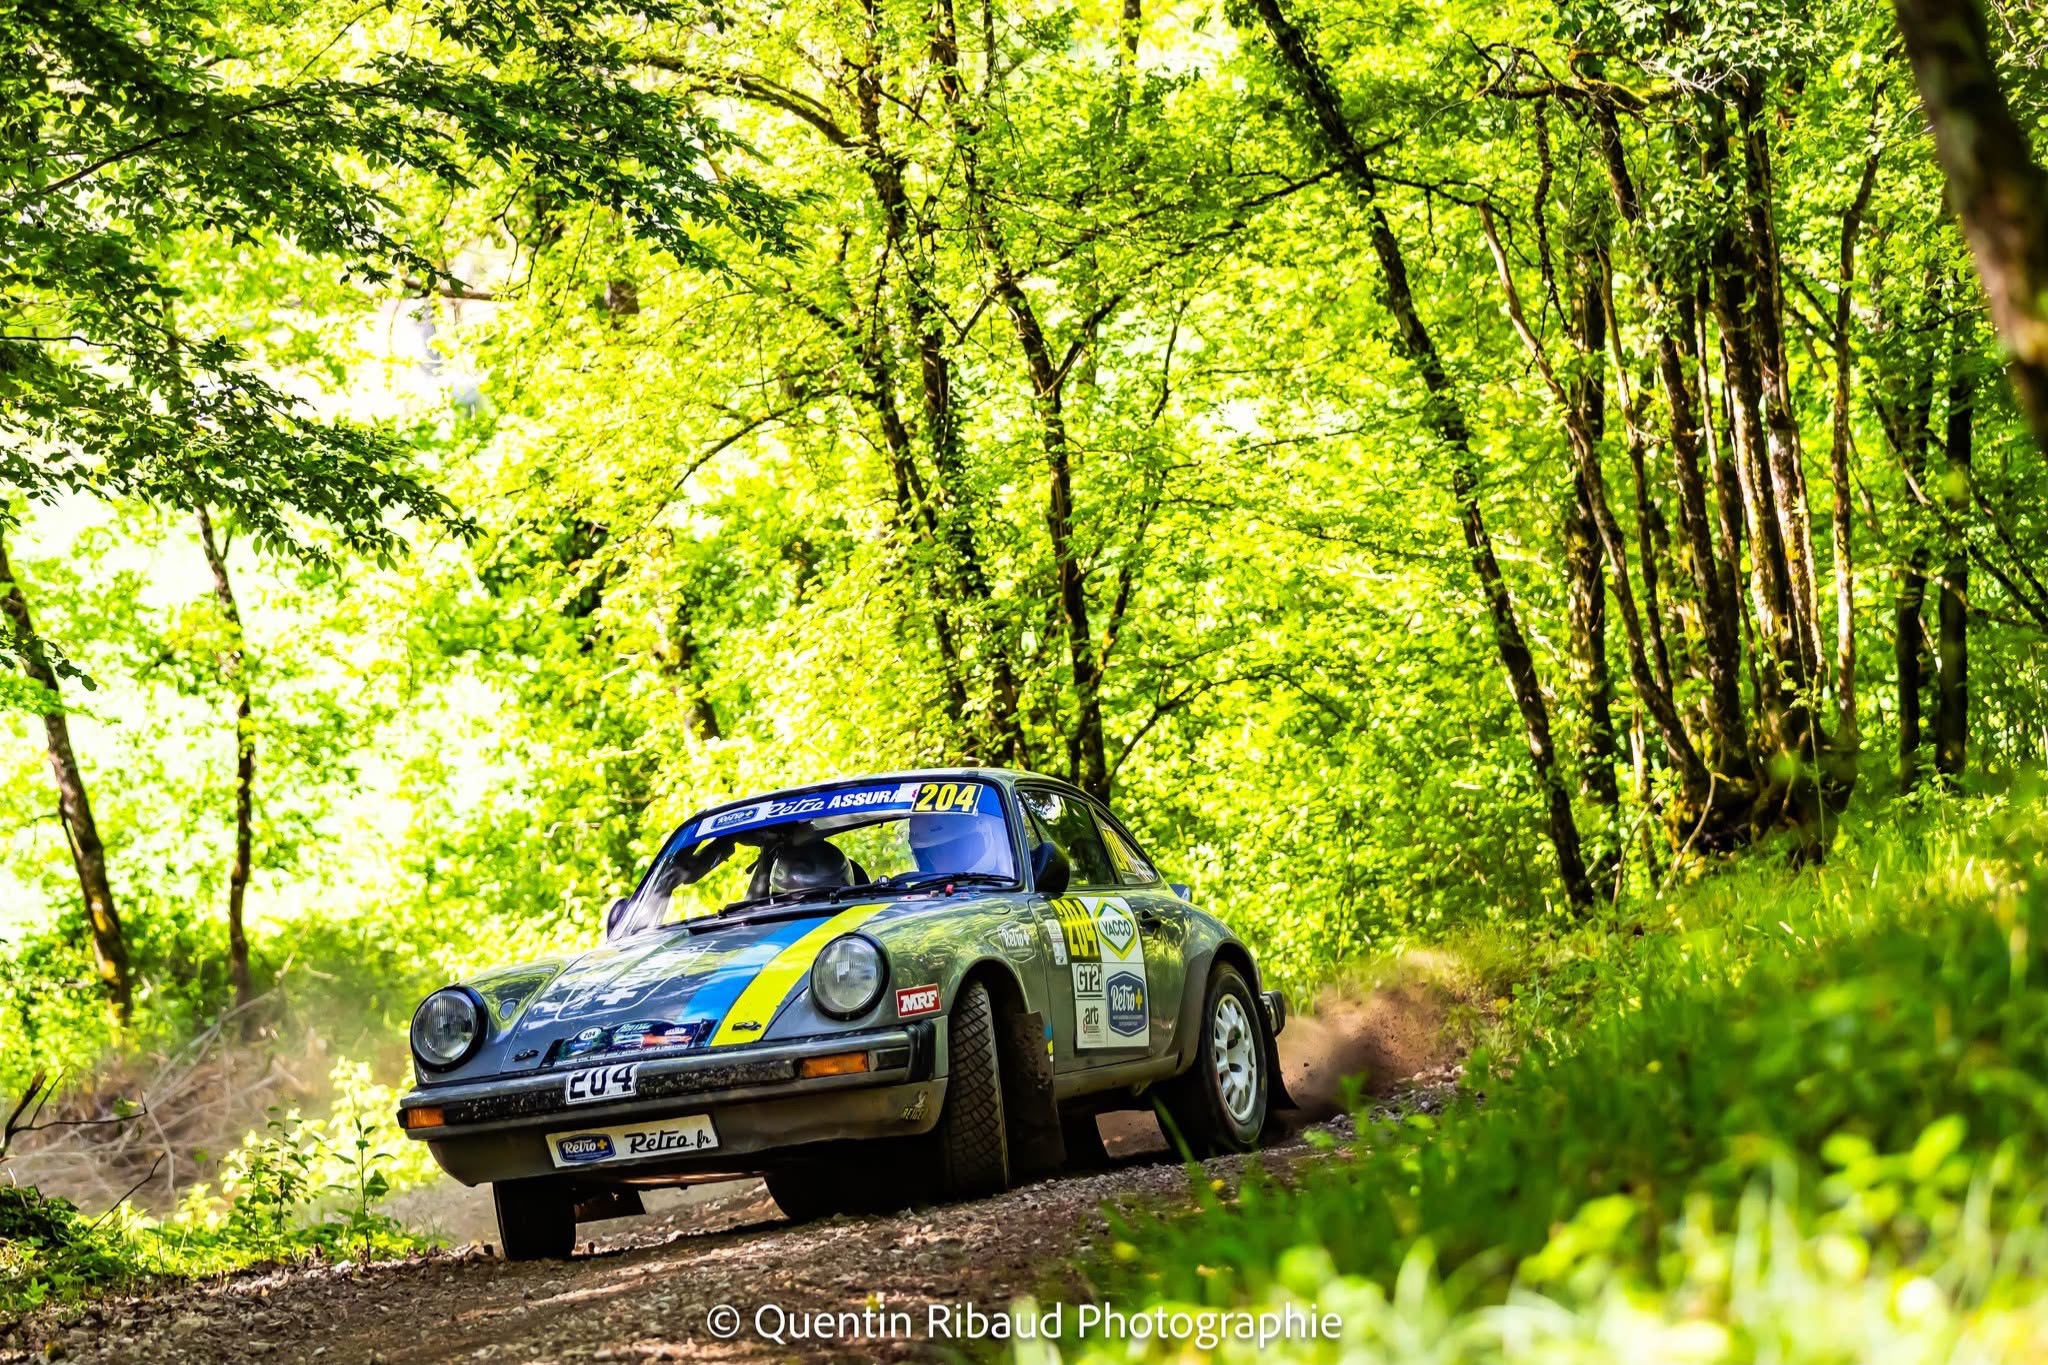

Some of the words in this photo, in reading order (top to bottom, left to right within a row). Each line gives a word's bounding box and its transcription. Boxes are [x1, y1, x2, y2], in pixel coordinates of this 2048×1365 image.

[916, 783, 977, 812] 204
[1051, 898, 1099, 957] 204
[1103, 918, 1131, 936] YACCO
[901, 990, 938, 1013] MRF
[1084, 1005, 1099, 1025] art
[584, 1031, 596, 1039] 204
[570, 1064, 634, 1099] 204
